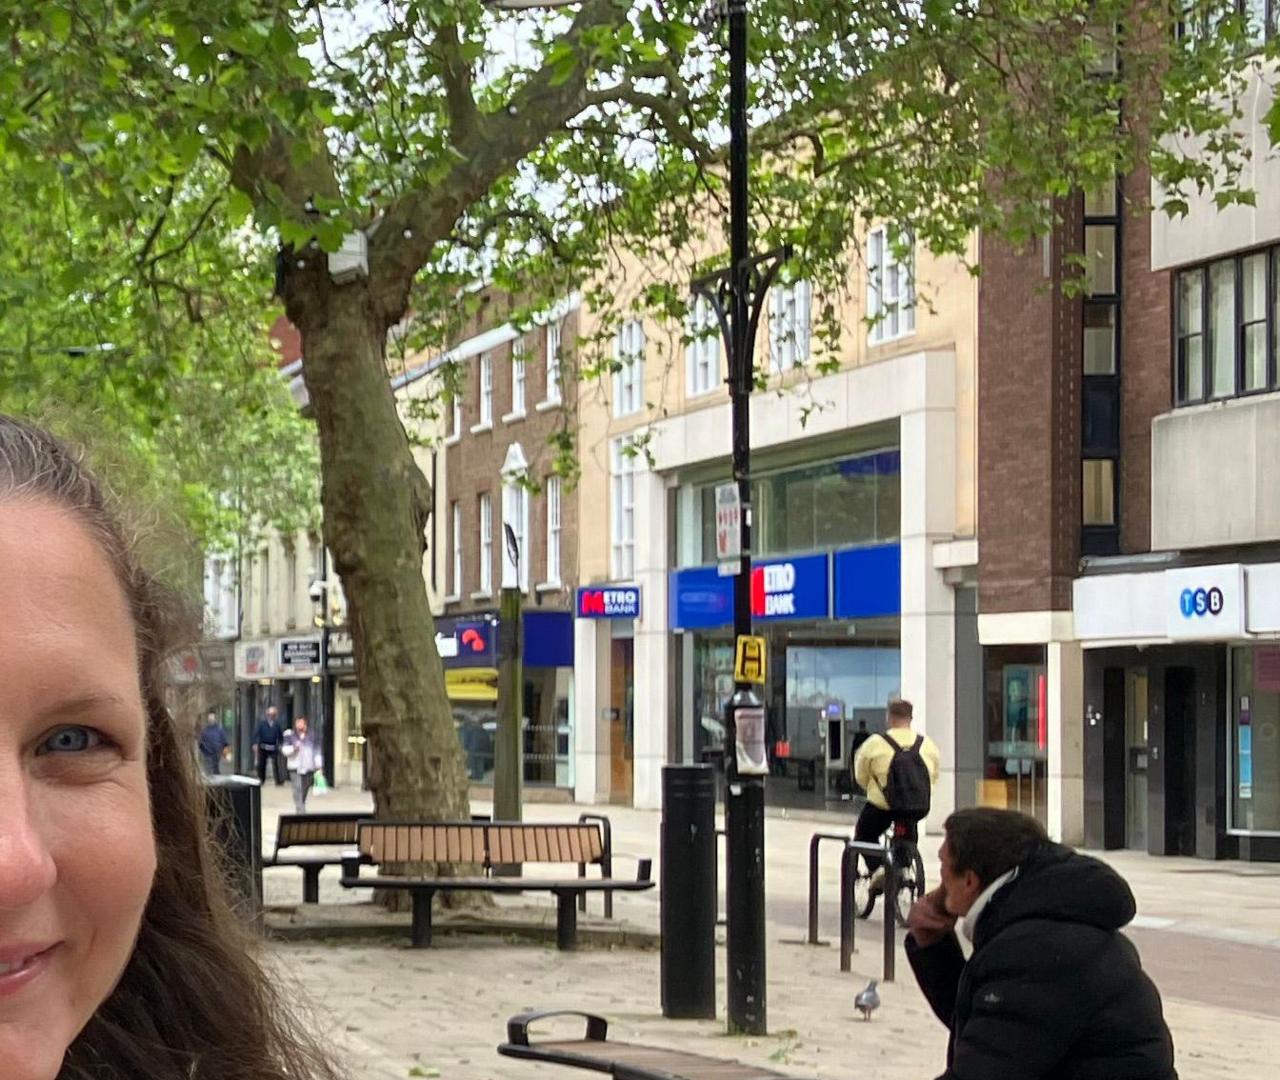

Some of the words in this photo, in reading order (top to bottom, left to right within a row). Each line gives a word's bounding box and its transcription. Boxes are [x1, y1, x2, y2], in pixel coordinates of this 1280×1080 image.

[582, 591, 636, 615] METRO
[605, 604, 635, 614] BANK
[765, 592, 795, 615] BANK
[1183, 589, 1221, 613] TSB
[741, 641, 761, 677] H
